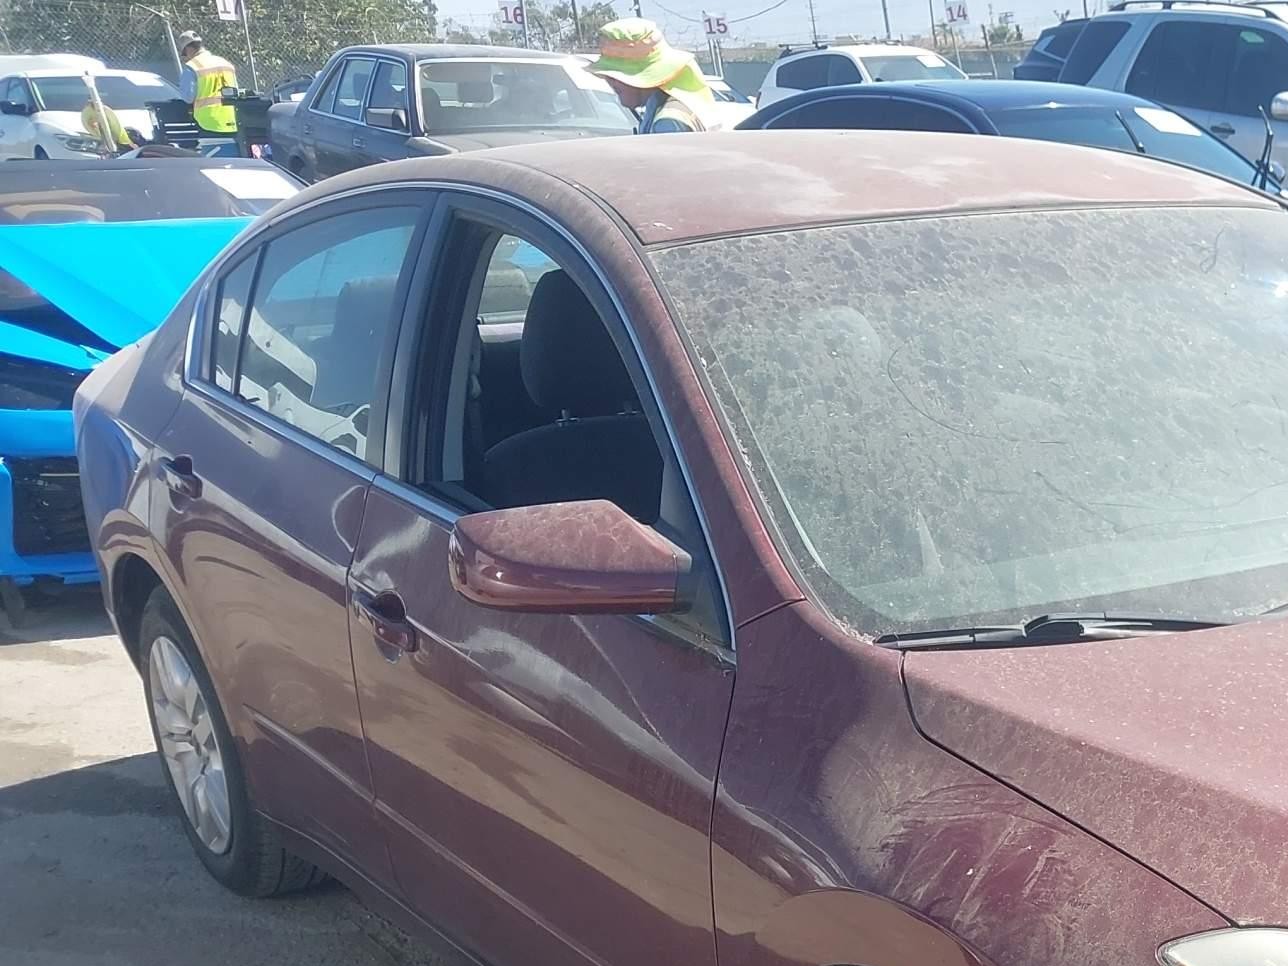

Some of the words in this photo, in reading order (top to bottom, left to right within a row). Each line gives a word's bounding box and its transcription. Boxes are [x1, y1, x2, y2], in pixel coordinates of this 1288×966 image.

[501, 6, 525, 25] 16
[945, 4, 968, 22] 14
[704, 17, 728, 35] 15
